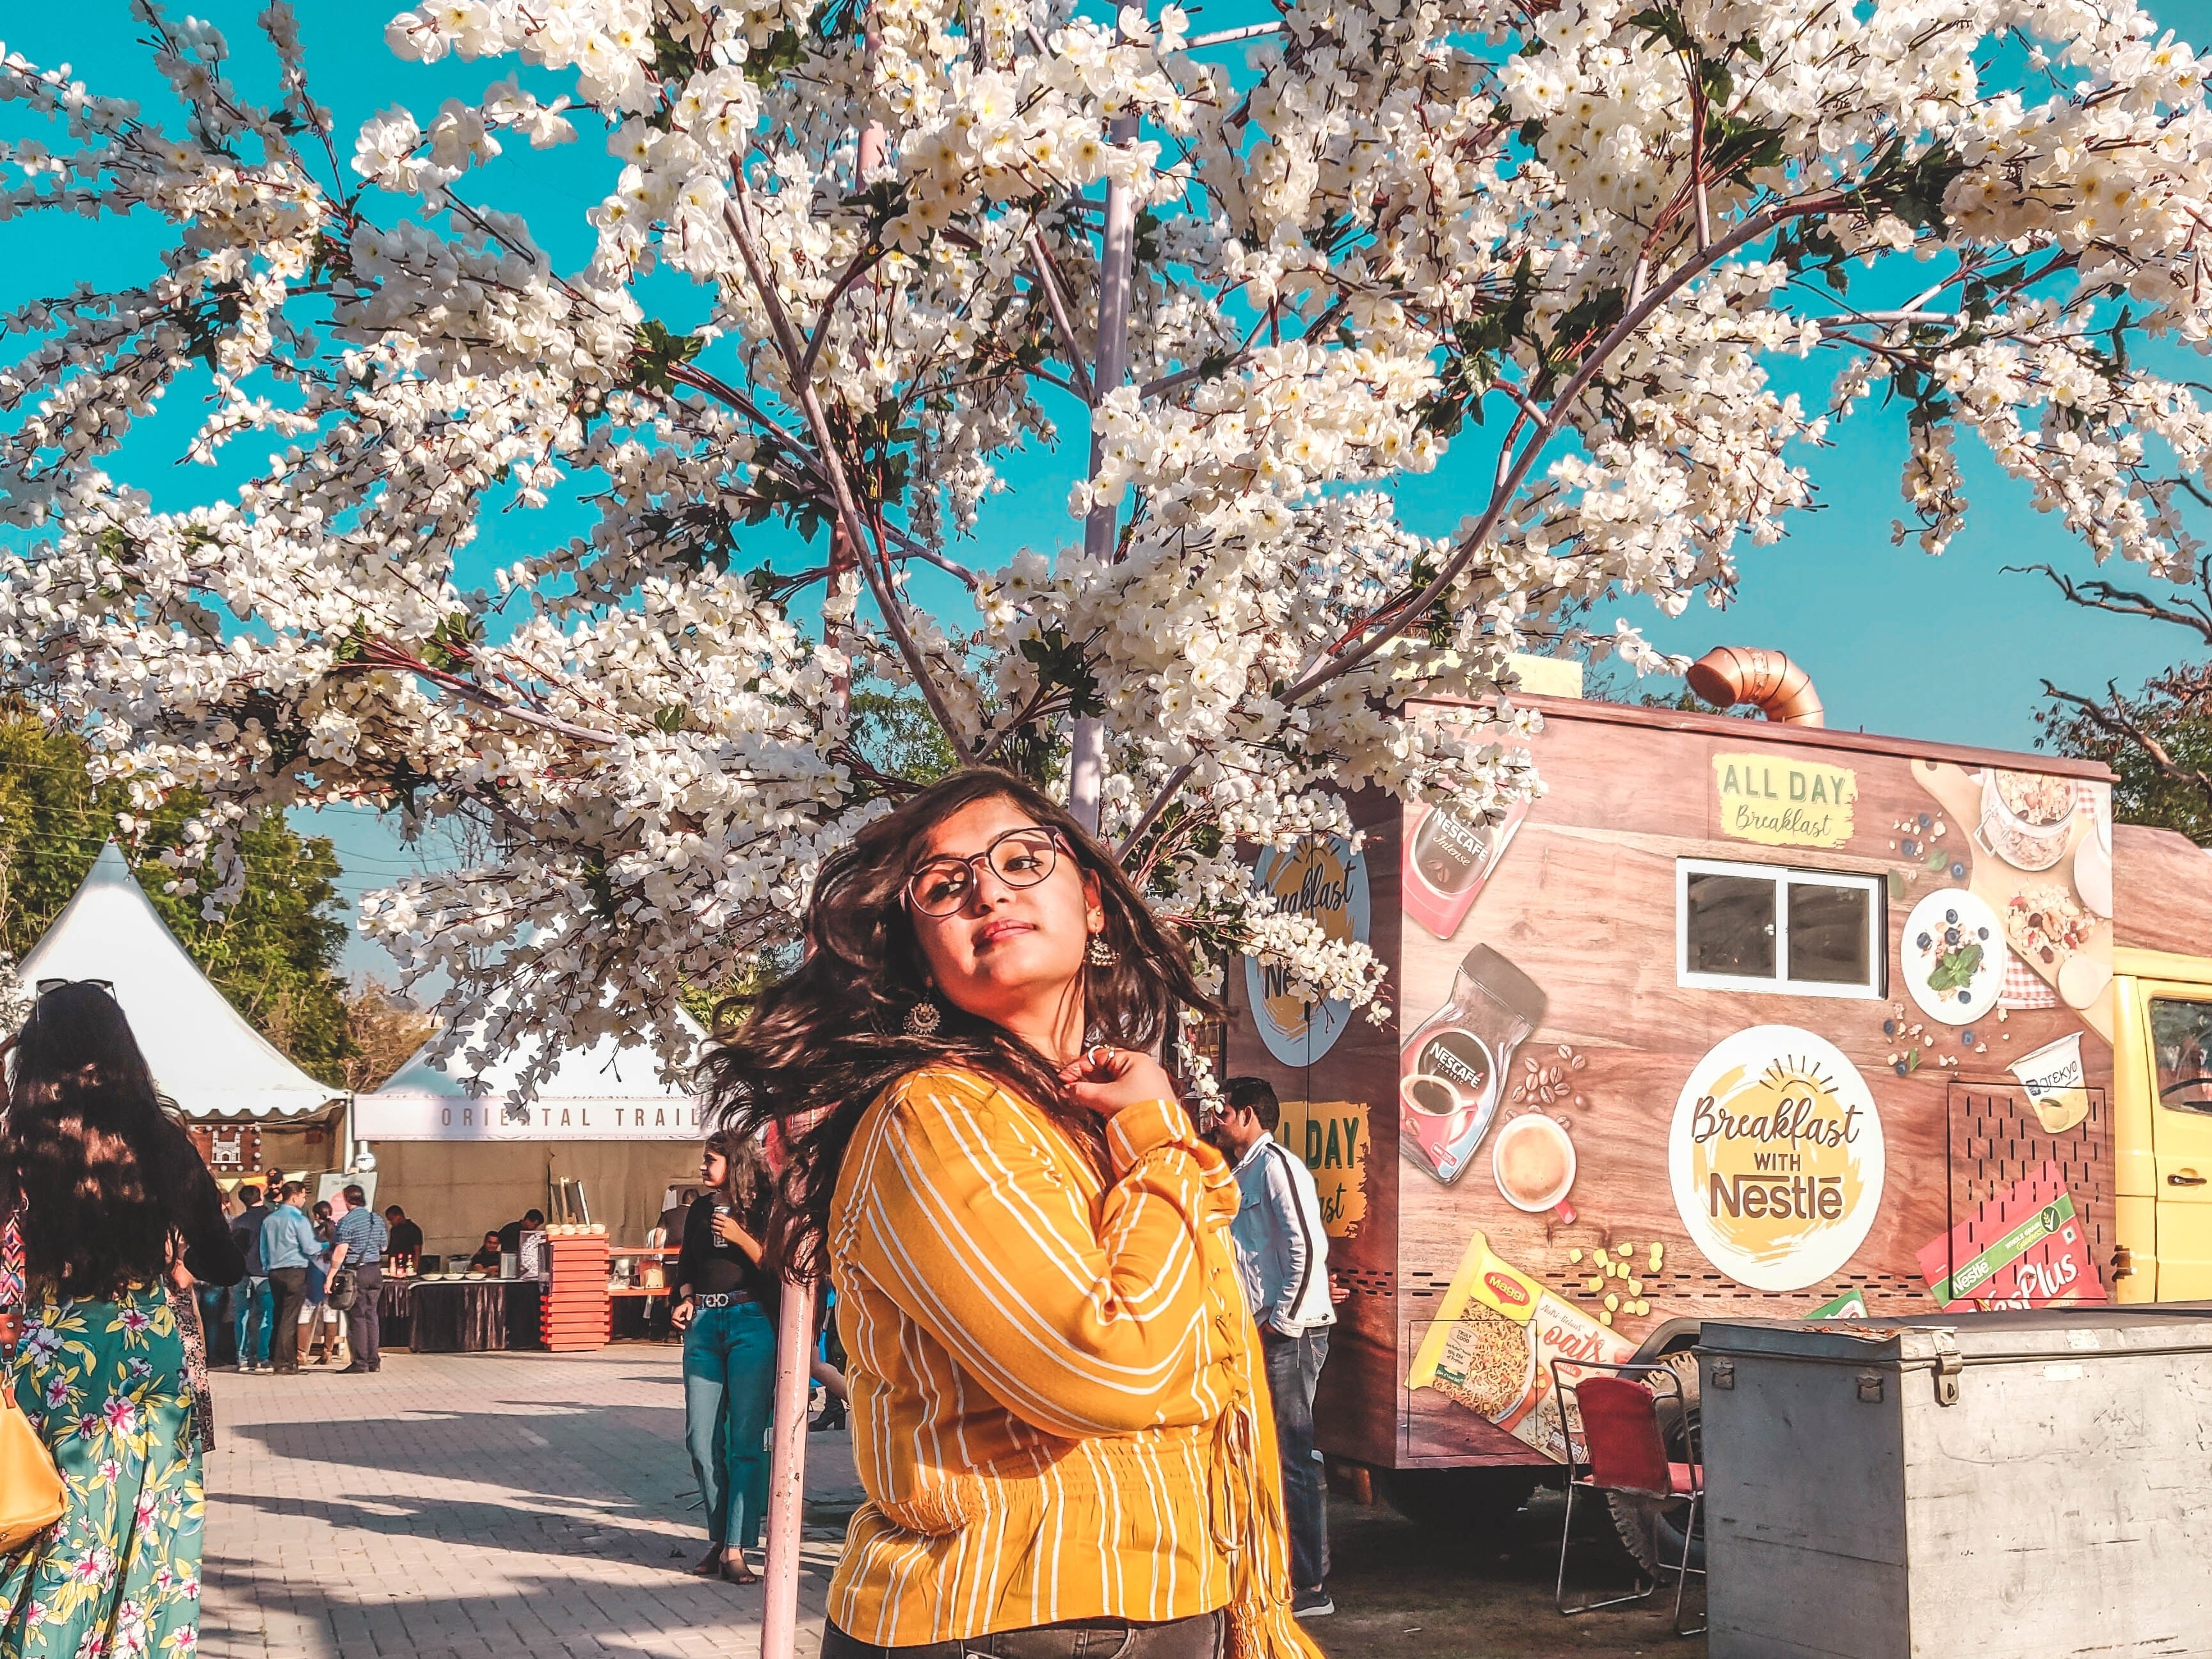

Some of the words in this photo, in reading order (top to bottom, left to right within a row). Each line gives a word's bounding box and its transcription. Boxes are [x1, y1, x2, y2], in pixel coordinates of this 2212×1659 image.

[1723, 764, 1778, 800] ALL
[1790, 771, 1845, 806] DAY
[1736, 804, 1833, 838] Breakfast
[1432, 834, 1471, 866] Intense
[1437, 1062, 1464, 1086] CLASSIC
[441, 1108, 591, 1126] ORIETAL
[1691, 1096, 1864, 1151] Breakfast
[1306, 1117, 1359, 1169] DAY
[1754, 1152, 1800, 1172] WITH
[1456, 1334, 1470, 1343] GOOD
[1458, 1329, 1472, 1339] TRULY
[1543, 1326, 1607, 1363] oats
